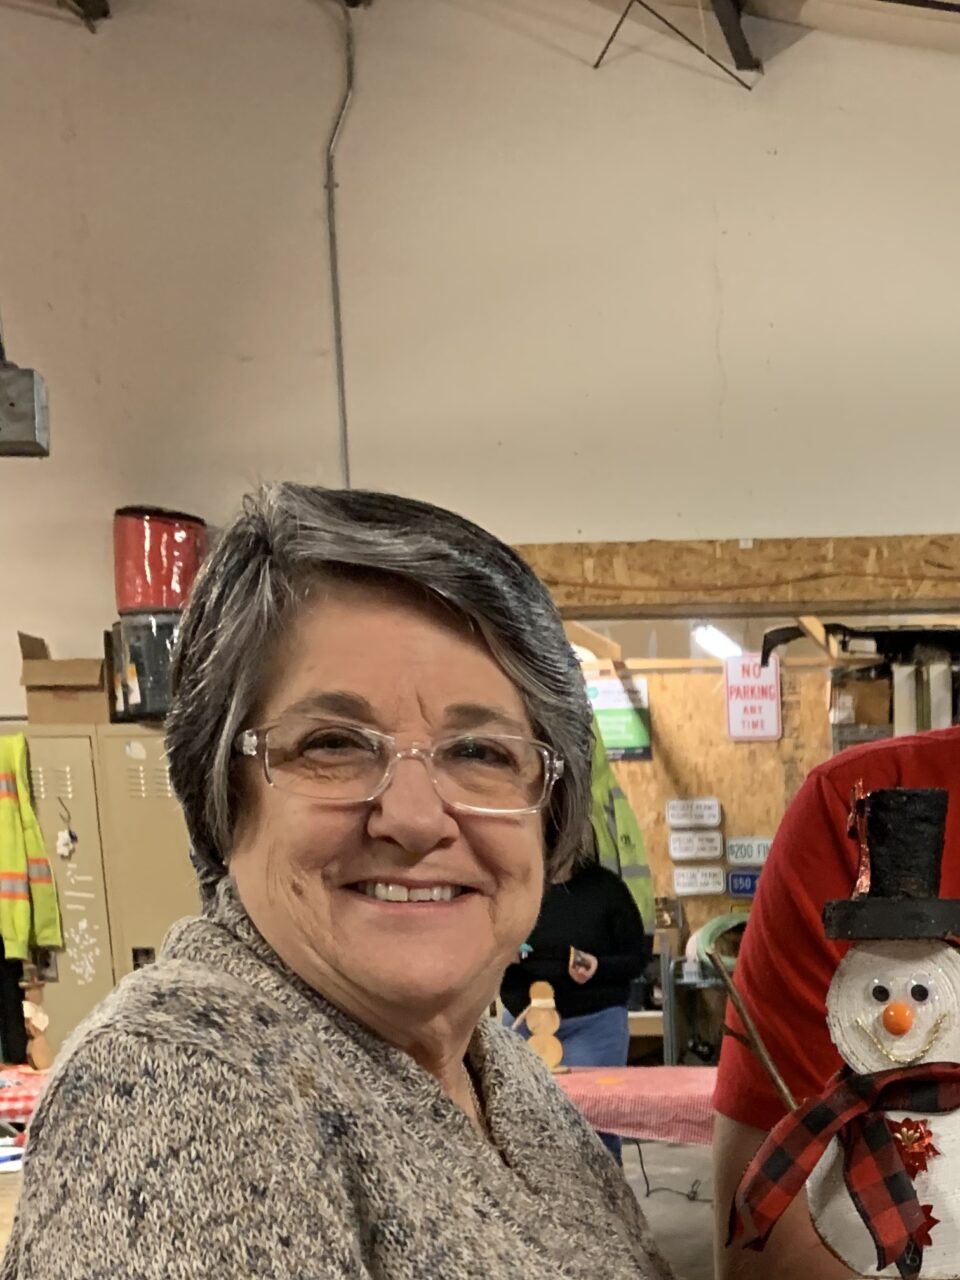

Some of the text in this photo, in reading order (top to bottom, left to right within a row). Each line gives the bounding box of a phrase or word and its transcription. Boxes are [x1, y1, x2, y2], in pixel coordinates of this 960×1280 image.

[742, 663, 762, 678] NO
[729, 685, 776, 700] PARKING
[743, 705, 762, 715] ANY
[742, 719, 765, 731] TIME
[728, 843, 754, 859] $200
[733, 877, 752, 890] $50
